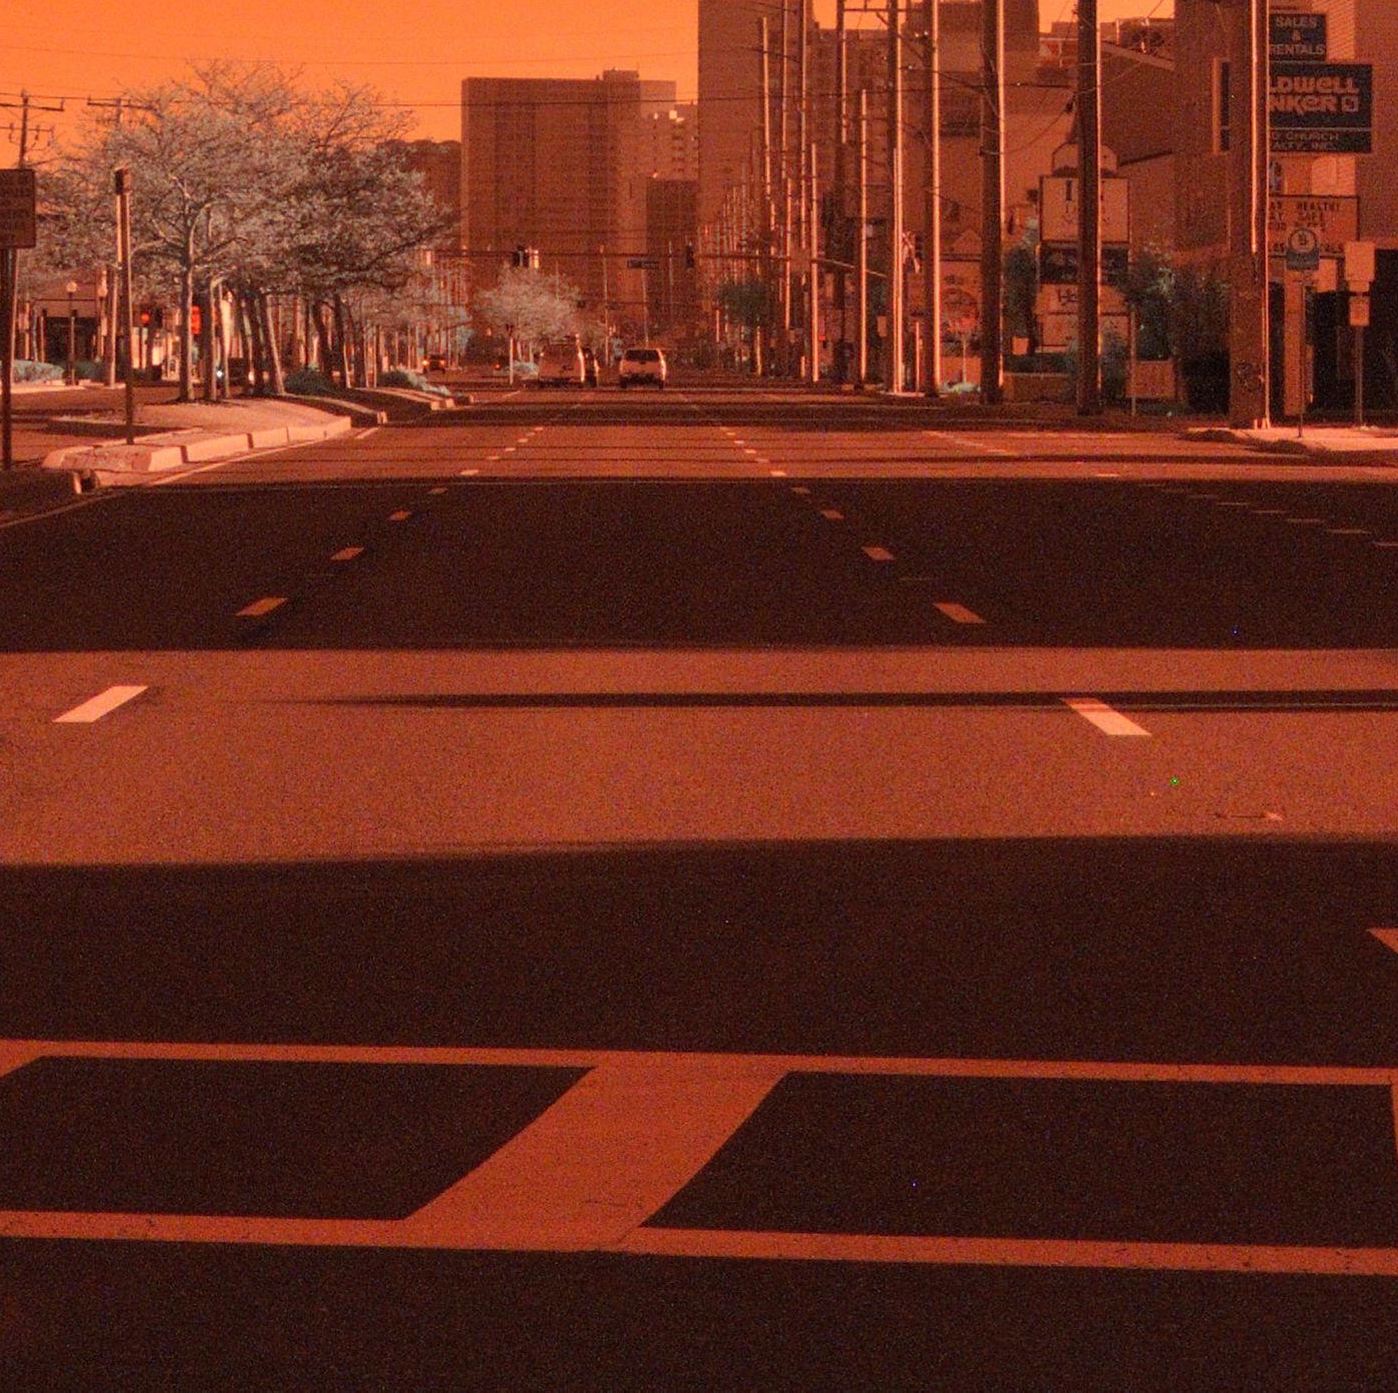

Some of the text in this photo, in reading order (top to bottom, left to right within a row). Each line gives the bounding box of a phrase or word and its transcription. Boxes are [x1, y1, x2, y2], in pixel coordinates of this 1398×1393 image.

[1275, 16, 1318, 28] SALES
[1270, 76, 1360, 94] LDWELL
[1270, 95, 1338, 115] NKER
